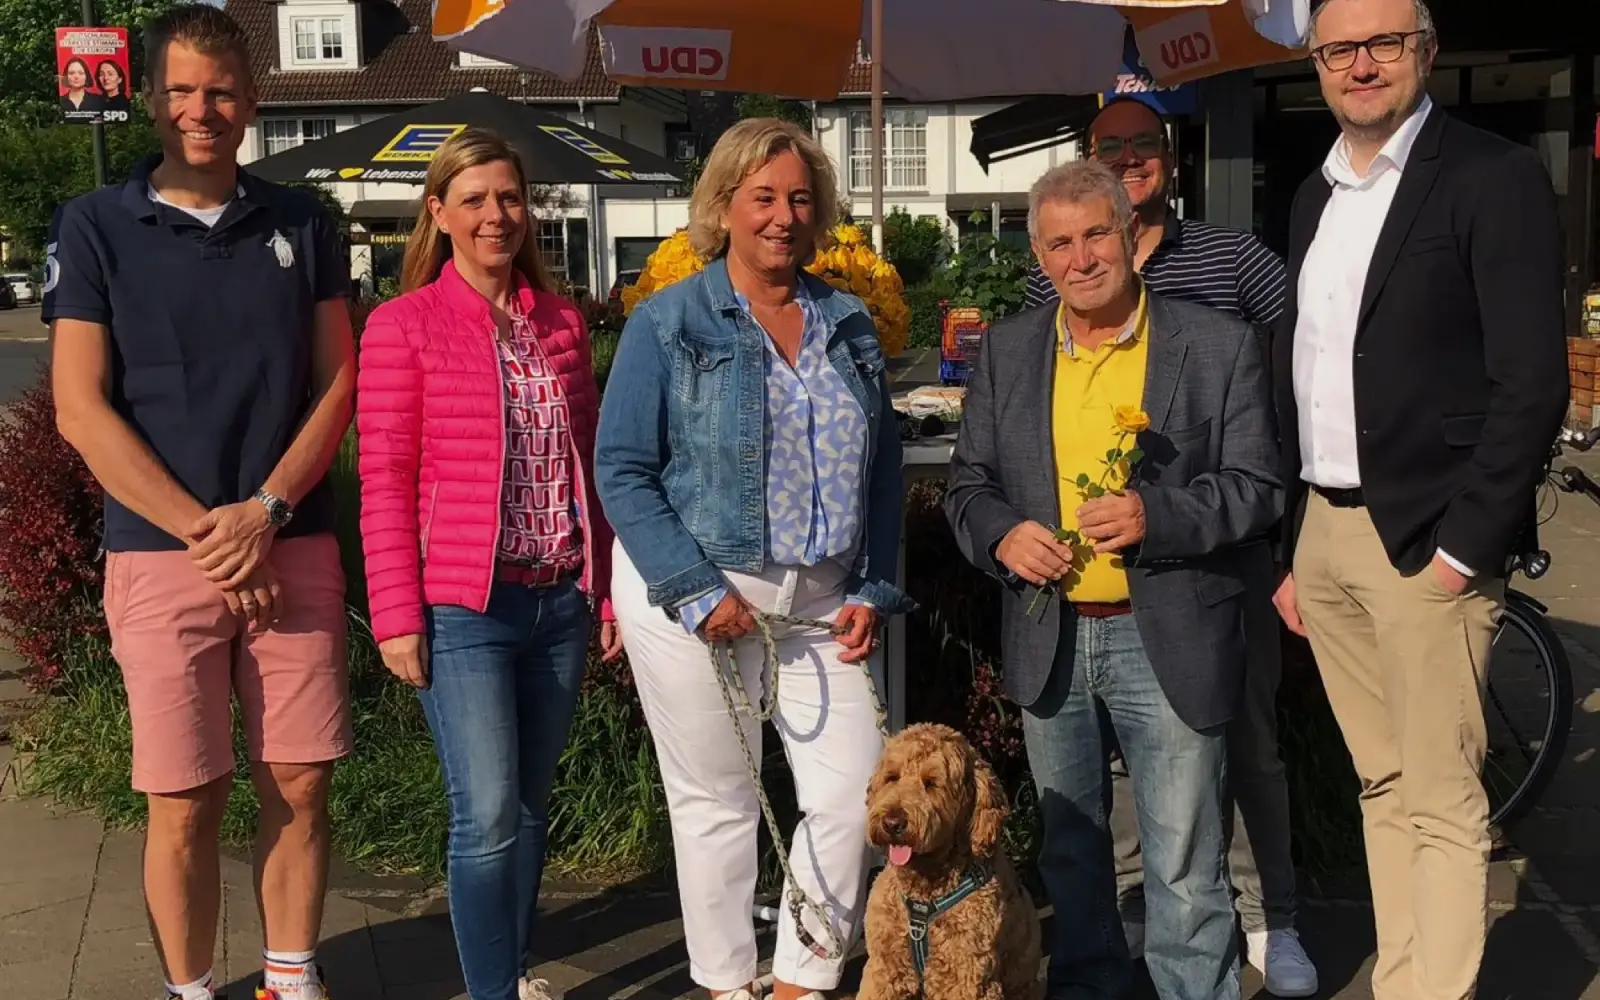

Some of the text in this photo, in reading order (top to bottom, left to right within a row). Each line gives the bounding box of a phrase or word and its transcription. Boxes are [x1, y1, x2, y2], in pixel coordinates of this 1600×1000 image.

[1114, 74, 1181, 94] Tchi
[103, 111, 128, 121] SPD
[305, 168, 428, 179] Wir Lebensm
